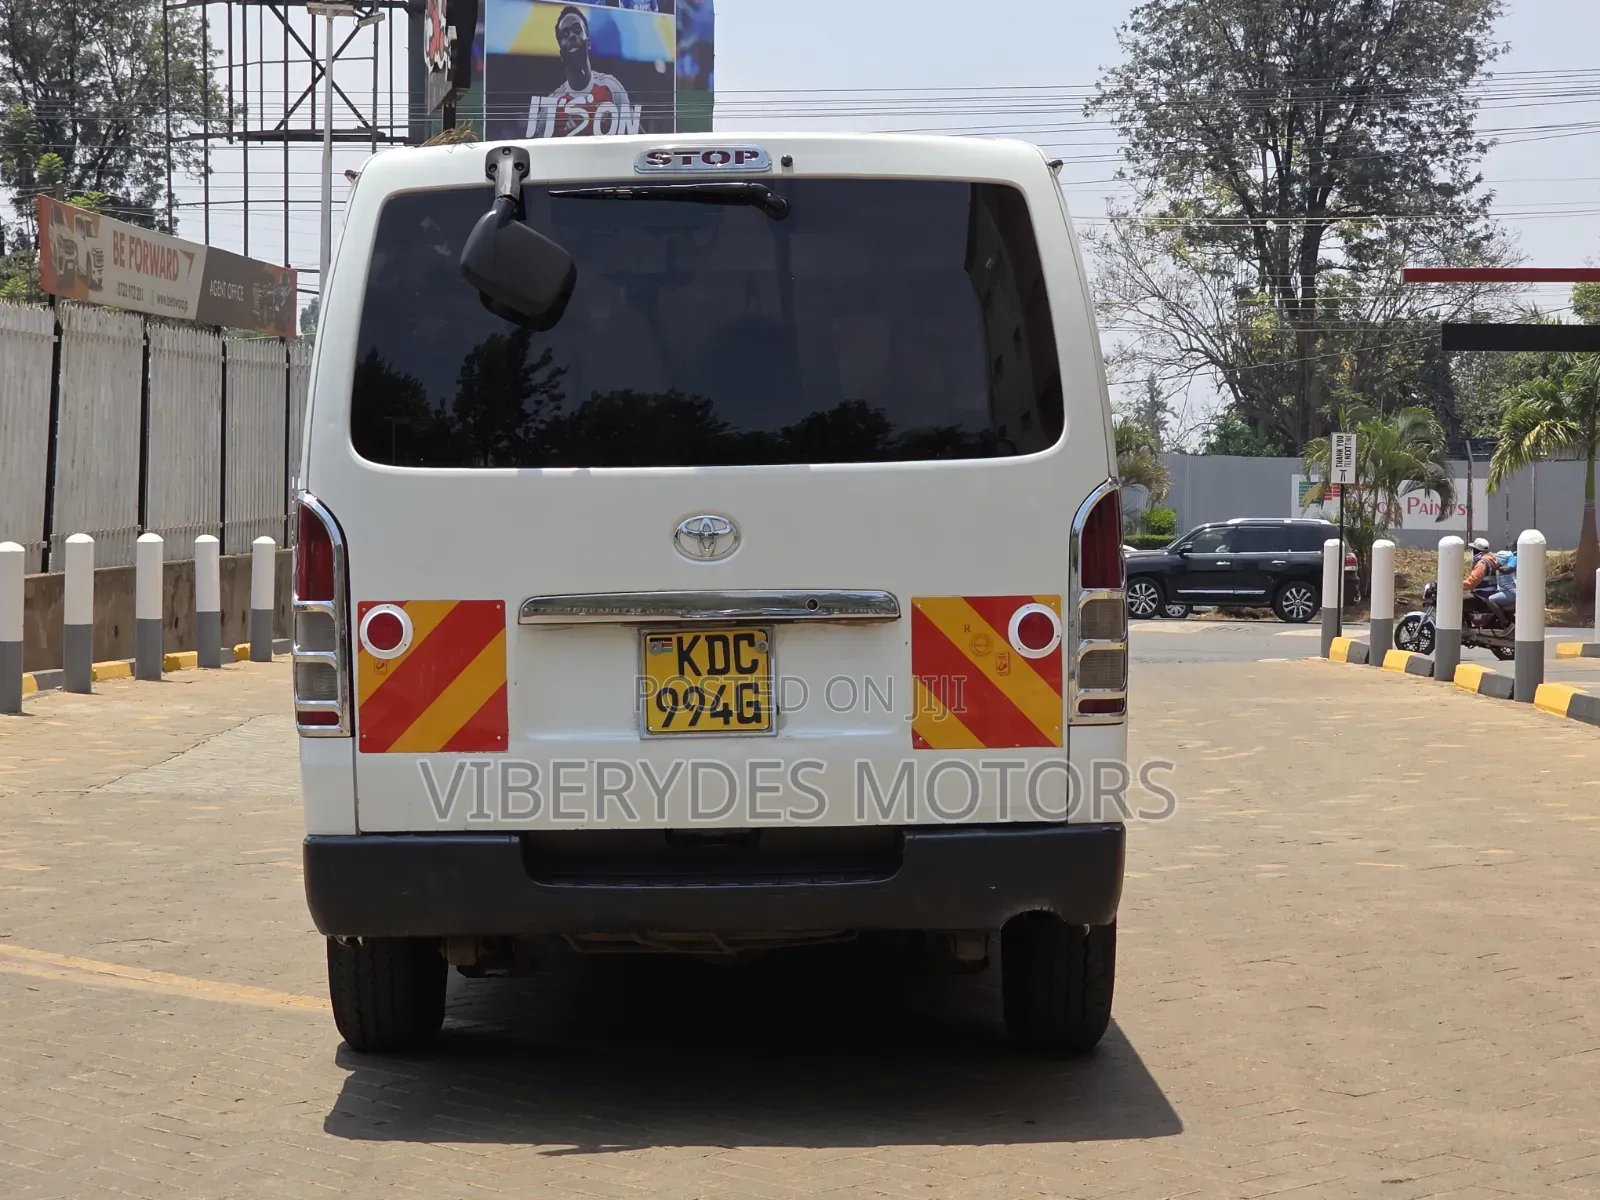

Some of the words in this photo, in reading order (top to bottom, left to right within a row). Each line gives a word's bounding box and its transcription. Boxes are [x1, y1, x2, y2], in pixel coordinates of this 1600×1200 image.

[525, 95, 590, 138] IT'S
[592, 101, 642, 137] ON
[645, 150, 760, 168] STOP
[112, 229, 126, 269] BE
[128, 235, 180, 282] FORWARD
[209, 279, 227, 298] AGENT
[227, 282, 245, 302] OFFICE
[1335, 435, 1344, 447] YOU
[1335, 448, 1344, 468] THANK
[1344, 446, 1352, 460] NEXT
[676, 633, 759, 677] KDC
[655, 682, 763, 728] 994G
